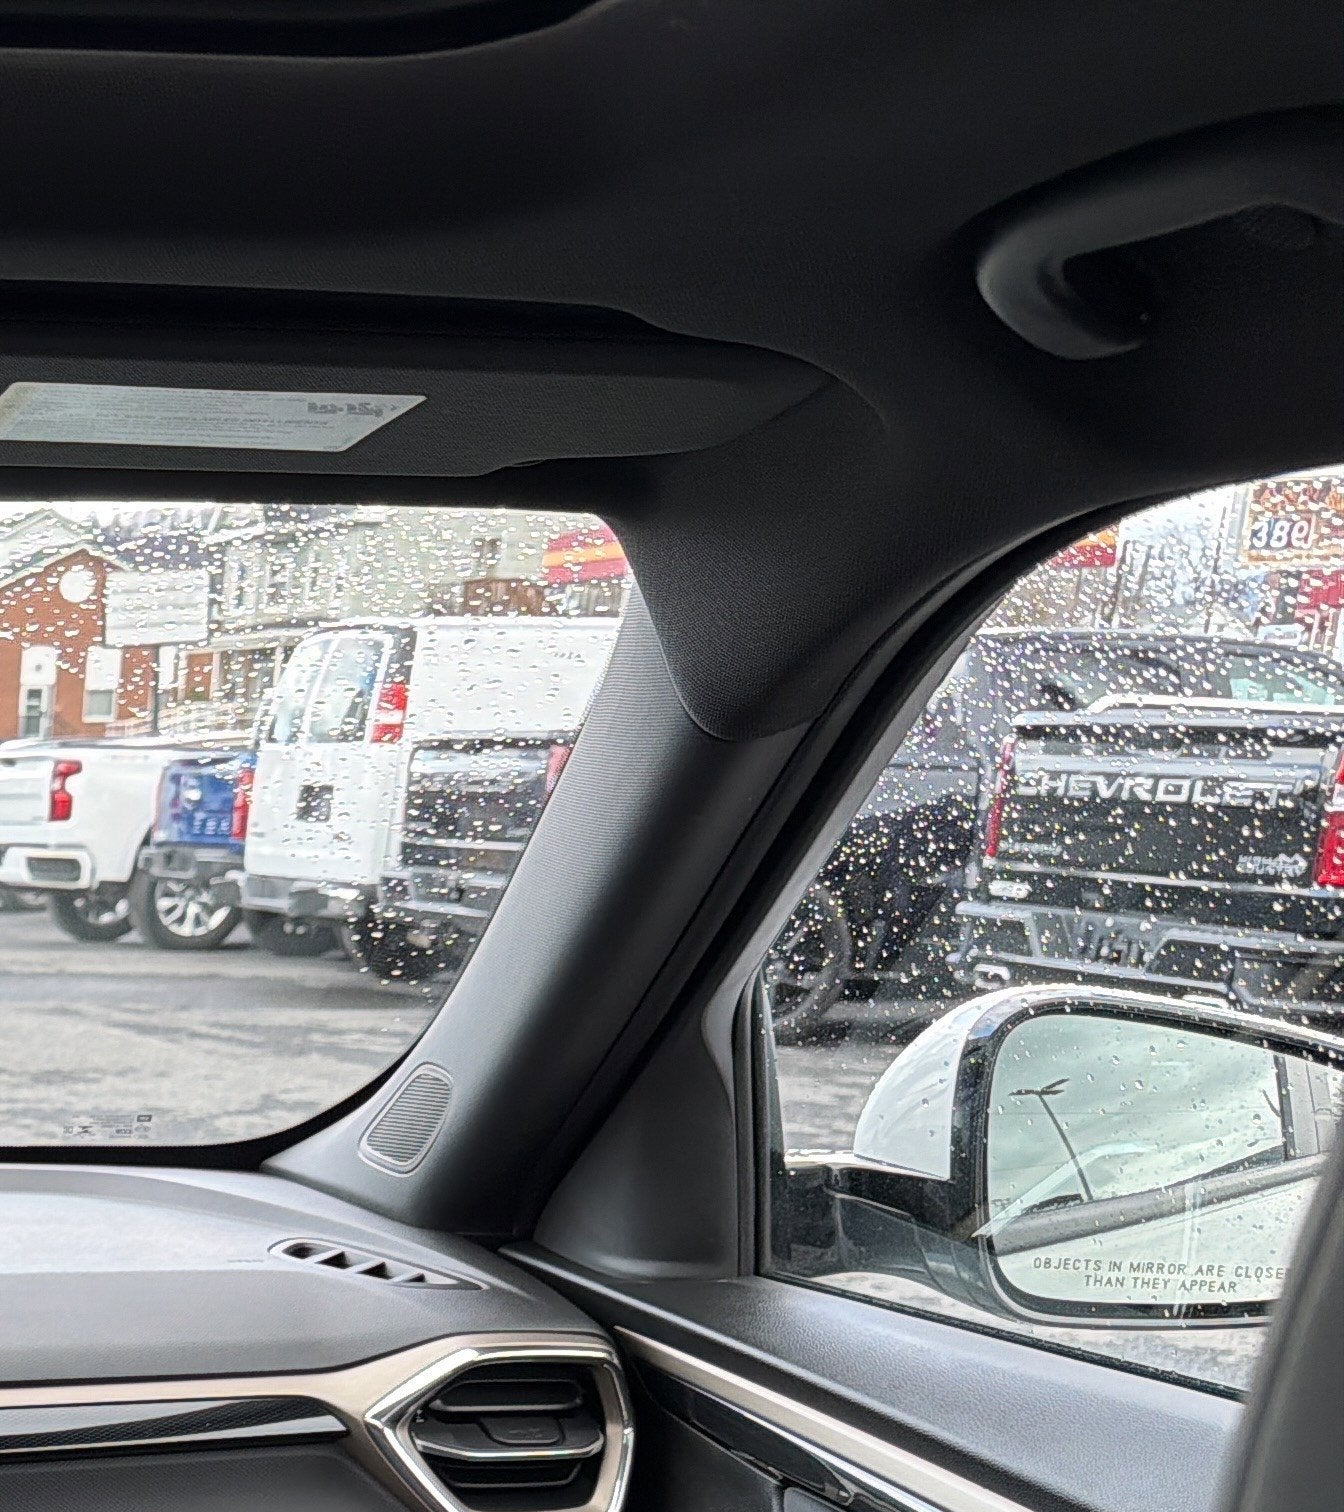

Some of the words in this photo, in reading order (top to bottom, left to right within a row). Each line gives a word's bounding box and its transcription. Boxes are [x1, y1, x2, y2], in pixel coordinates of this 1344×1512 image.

[1014, 772, 1295, 808] CHEVROLET
[1033, 1257, 1102, 1272] OBJECTS
[1108, 1261, 1122, 1273] IN
[1129, 1261, 1186, 1275] MIRROR
[1195, 1265, 1225, 1277] ARE
[1084, 1275, 1125, 1288] THAN
[1132, 1277, 1170, 1290] THEY
[1179, 1280, 1237, 1293] APPEAR
